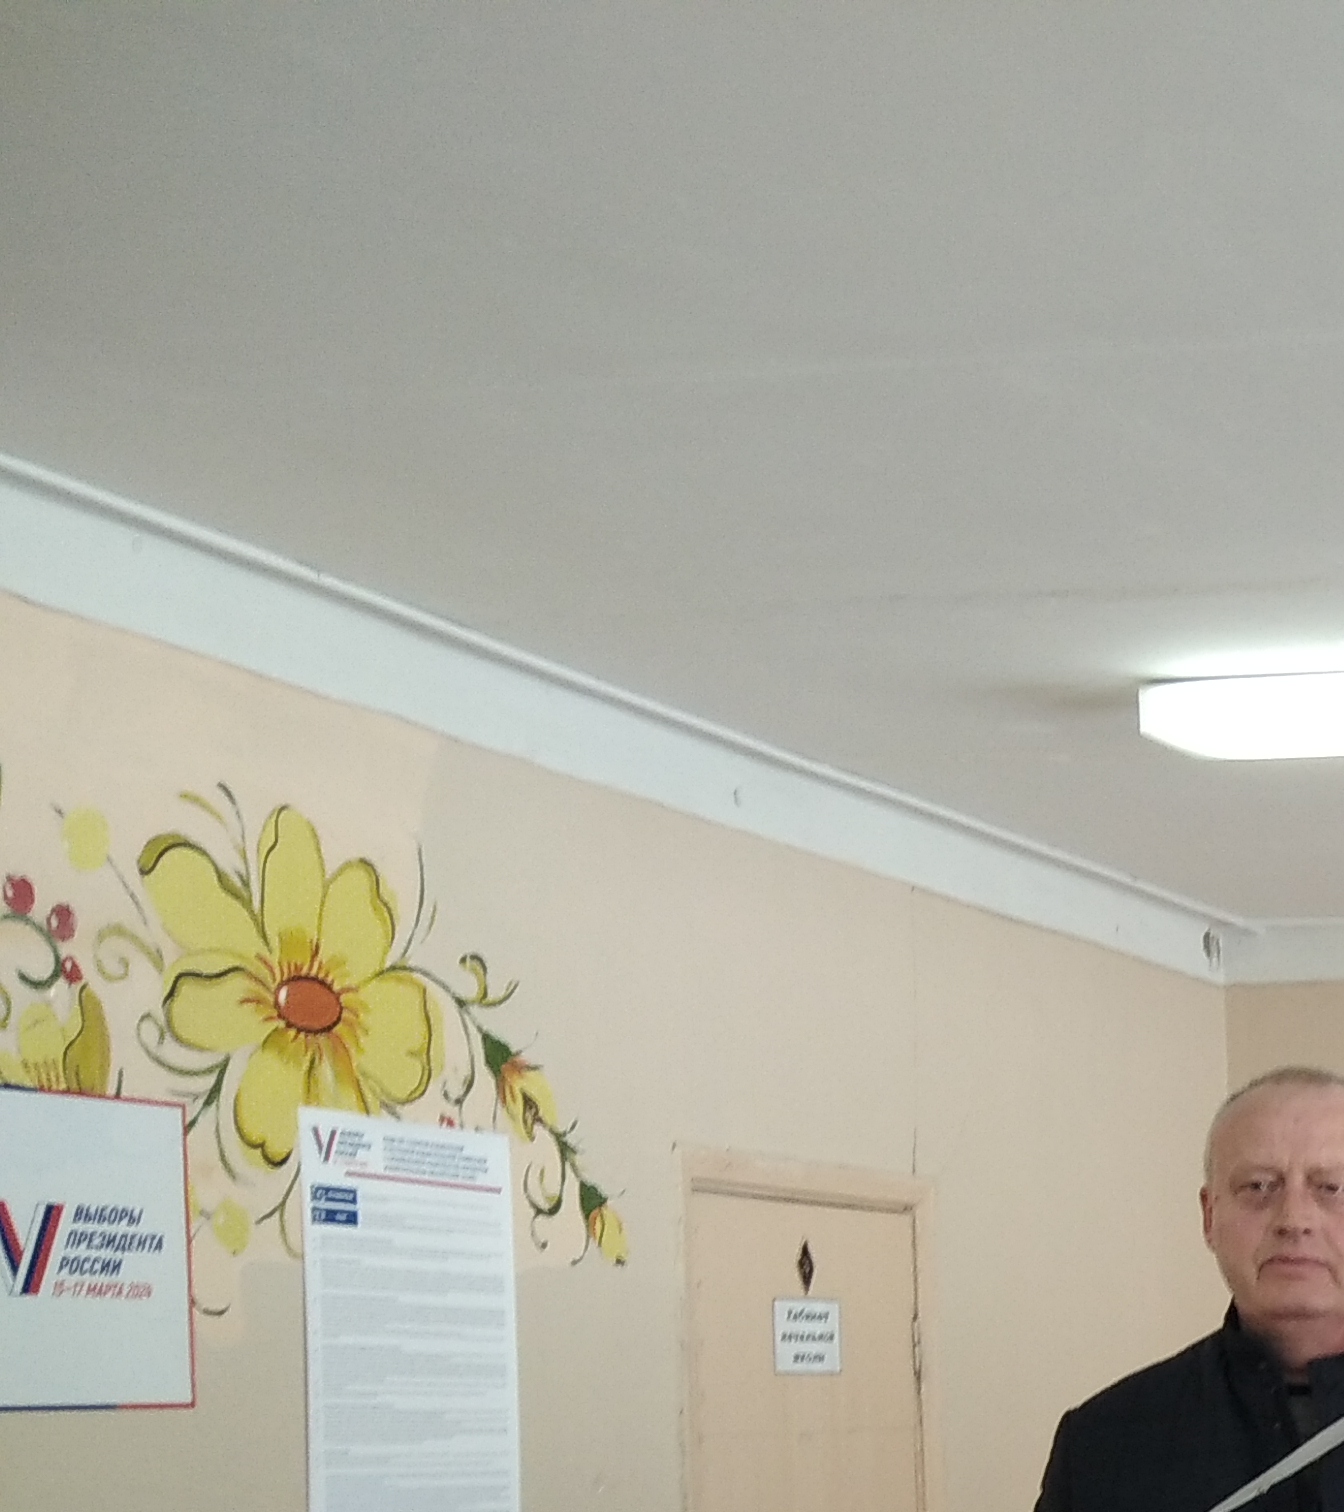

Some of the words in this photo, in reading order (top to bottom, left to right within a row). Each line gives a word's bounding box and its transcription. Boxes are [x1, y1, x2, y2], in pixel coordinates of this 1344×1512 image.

[72, 1203, 144, 1227] ВЫБОРЫ
[64, 1229, 165, 1254] ПРЕЗИДЕНТА
[56, 1255, 123, 1277] РОССИИ
